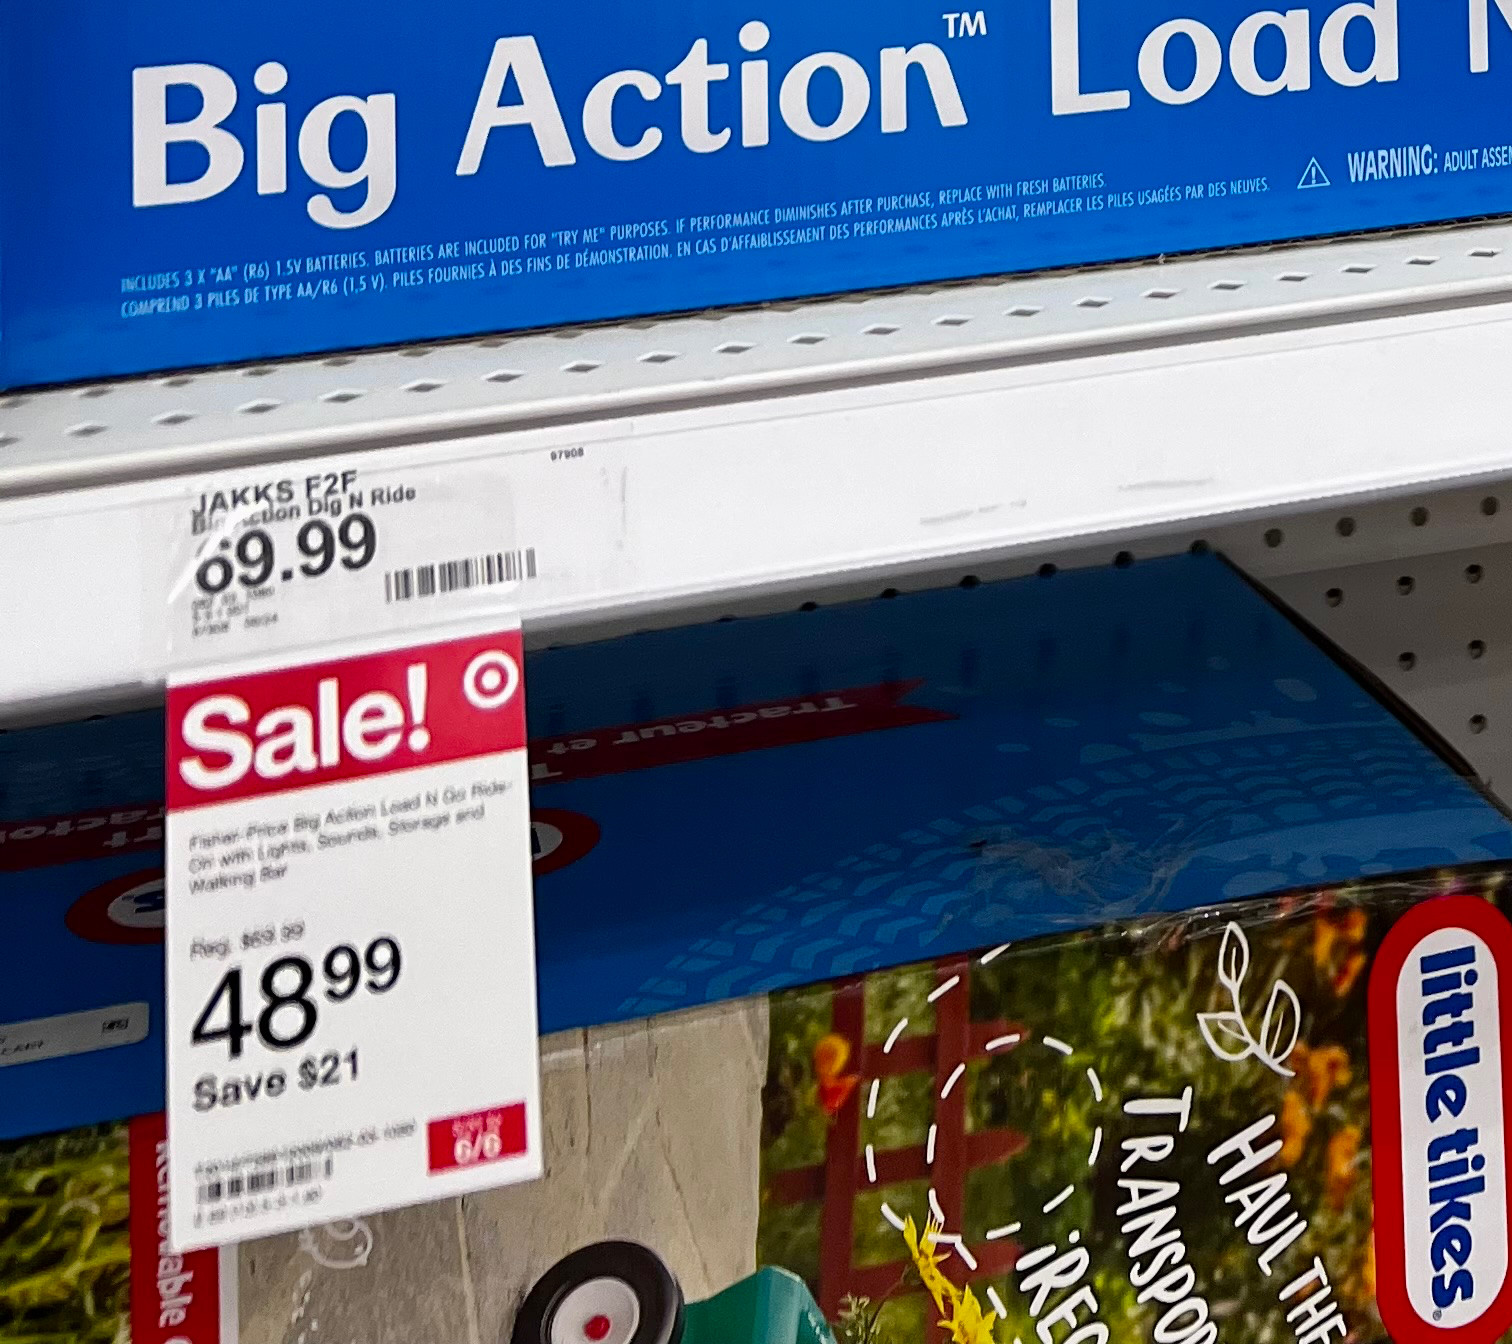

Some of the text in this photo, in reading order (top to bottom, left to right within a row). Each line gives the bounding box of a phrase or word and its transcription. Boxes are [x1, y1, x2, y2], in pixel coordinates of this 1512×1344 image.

[131, 60, 398, 230] Big
[1347, 143, 1438, 184] WARNING:
[1442, 147, 1478, 173] ADULT
[243, 261, 270, 282] (R6)
[275, 258, 301, 277] 1.5V
[305, 251, 370, 274] BATTERIES.
[374, 244, 434, 266] BATTERIES
[437, 241, 460, 260] ARE
[464, 236, 520, 257] INCLUDED
[523, 232, 547, 251] FOR
[609, 218, 671, 241] PURPOSES.
[675, 217, 686, 234] IF
[689, 209, 771, 233] PERFORMANCE
[774, 201, 837, 225] DIMINISHES
[840, 197, 874, 217] AFTER
[876, 190, 936, 215] PURCHASE,
[938, 185, 983, 207] REPLACE
[985, 182, 1014, 202] WITH
[1016, 178, 1050, 198] FRESH
[243, 287, 261, 304] DE
[264, 283, 293, 302] TYPE
[296, 278, 338, 298] AA/R6
[392, 268, 424, 288] PILES
[427, 262, 485, 285] FOURNIES
[500, 259, 523, 278] DES
[526, 255, 553, 275] FINS
[556, 253, 572, 272] DE
[676, 240, 692, 258] EN
[695, 237, 717, 256] CAS
[828, 221, 850, 241] DES
[853, 213, 938, 238] PERFORMANCES
[1022, 197, 1083, 220] REMPLACER
[1086, 194, 1104, 213] LES
[1107, 191, 1136, 210] PILES
[1184, 183, 1204, 201] PAR
[1208, 181, 1228, 198] DES
[305, 469, 358, 499] F2F
[370, 486, 417, 507] Ride
[178, 662, 432, 790] Sale!
[192, 1047, 359, 1113] Save $21
[1418, 945, 1488, 1310] little tikes
[1207, 1114, 1308, 1276] HAUL
